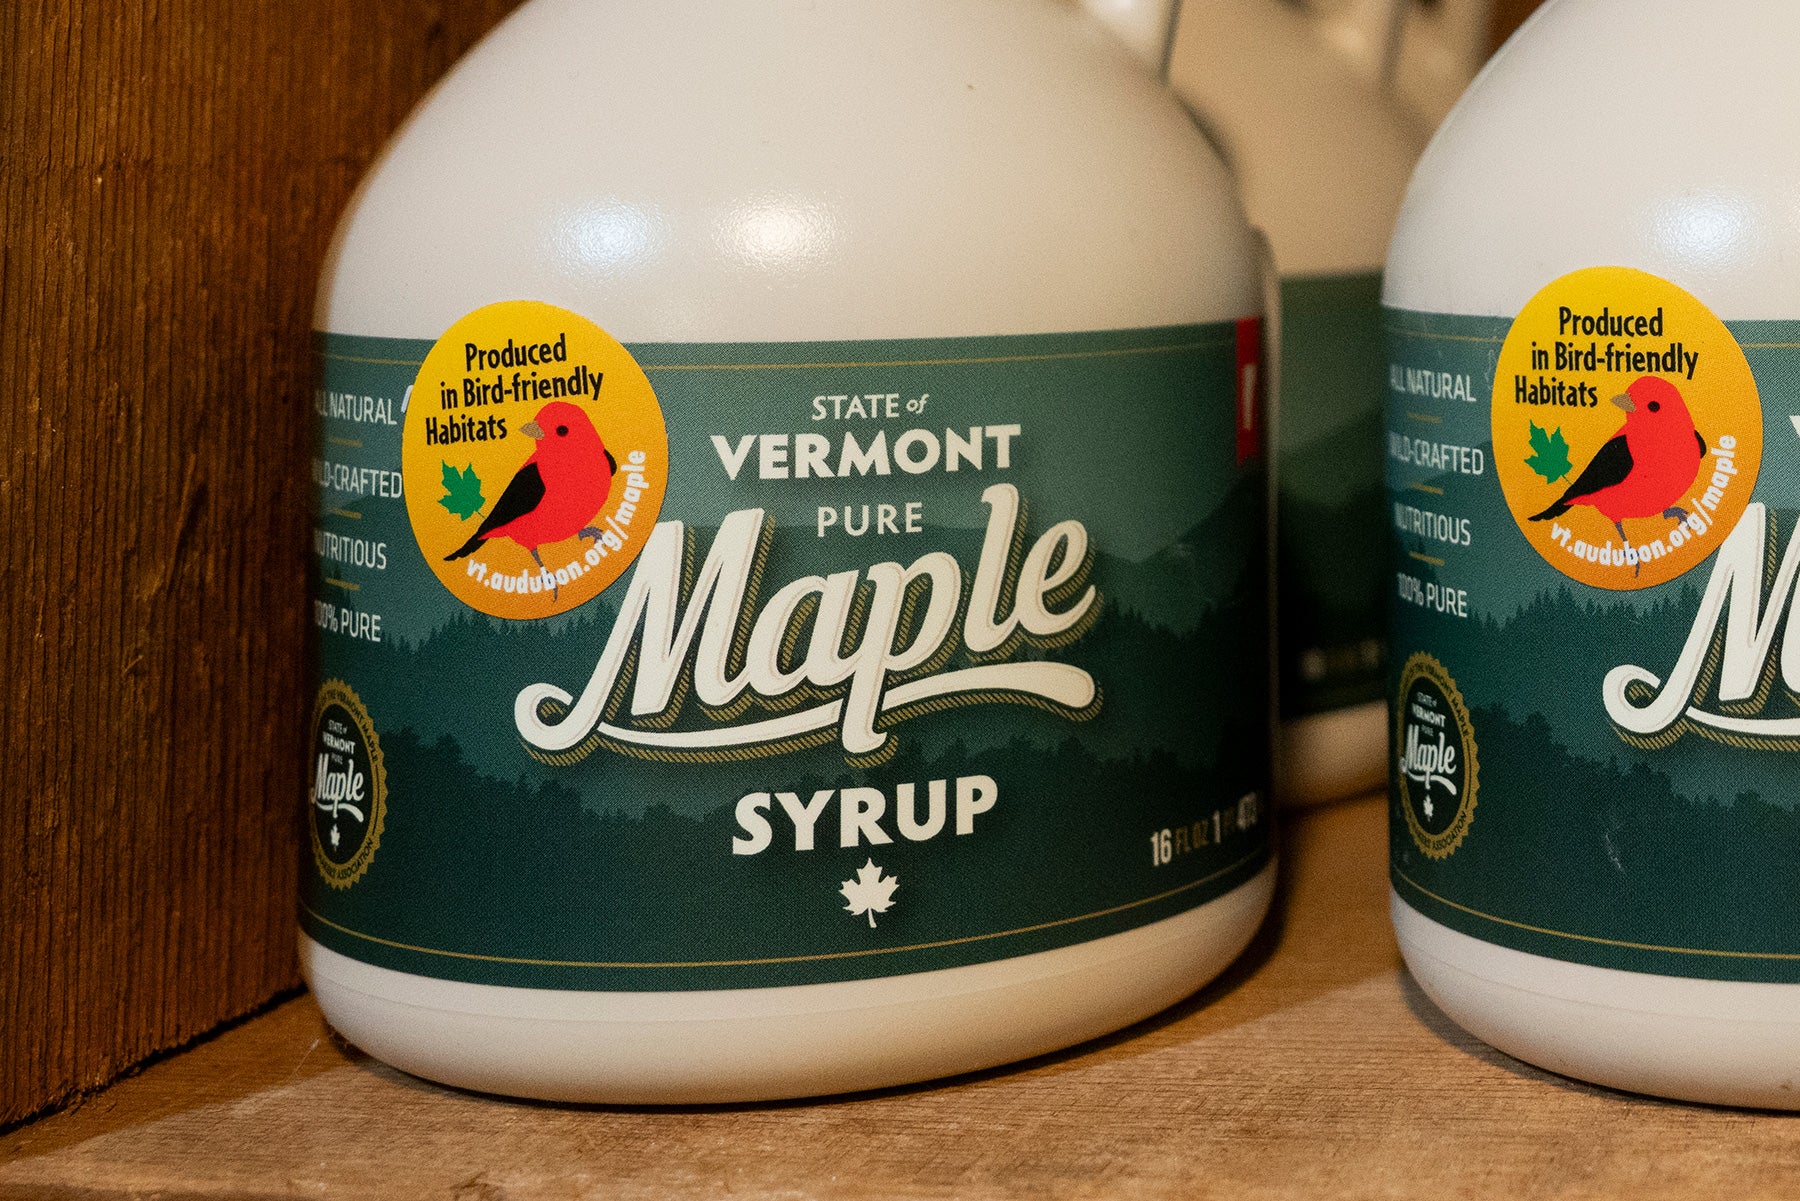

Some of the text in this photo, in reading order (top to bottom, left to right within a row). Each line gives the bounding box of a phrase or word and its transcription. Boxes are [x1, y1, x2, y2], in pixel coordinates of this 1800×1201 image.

[1558, 306, 1663, 337] Produced
[465, 333, 567, 372] Produced
[1531, 341, 1699, 380] in Bird-friendly
[441, 365, 603, 409] in Bird-friendly
[1406, 367, 1477, 402] NATURAL
[1514, 375, 1598, 408] Habitats
[329, 392, 398, 426] NATURAL
[811, 393, 930, 421] STATE of
[425, 414, 507, 446] Habitats
[710, 424, 1021, 480] VERMONT
[817, 502, 923, 537] PURE
[1551, 434, 1737, 567] vt.audubon.org/maple
[466, 450, 648, 595] vt.audubon.org/maple
[514, 482, 1098, 754] Maple
[1426, 582, 1468, 618] PURE
[340, 607, 381, 642] PURE
[1400, 723, 1457, 795] Maple
[311, 752, 365, 822] Maple
[732, 774, 998, 855] SYRUP
[1150, 828, 1172, 867] 16
